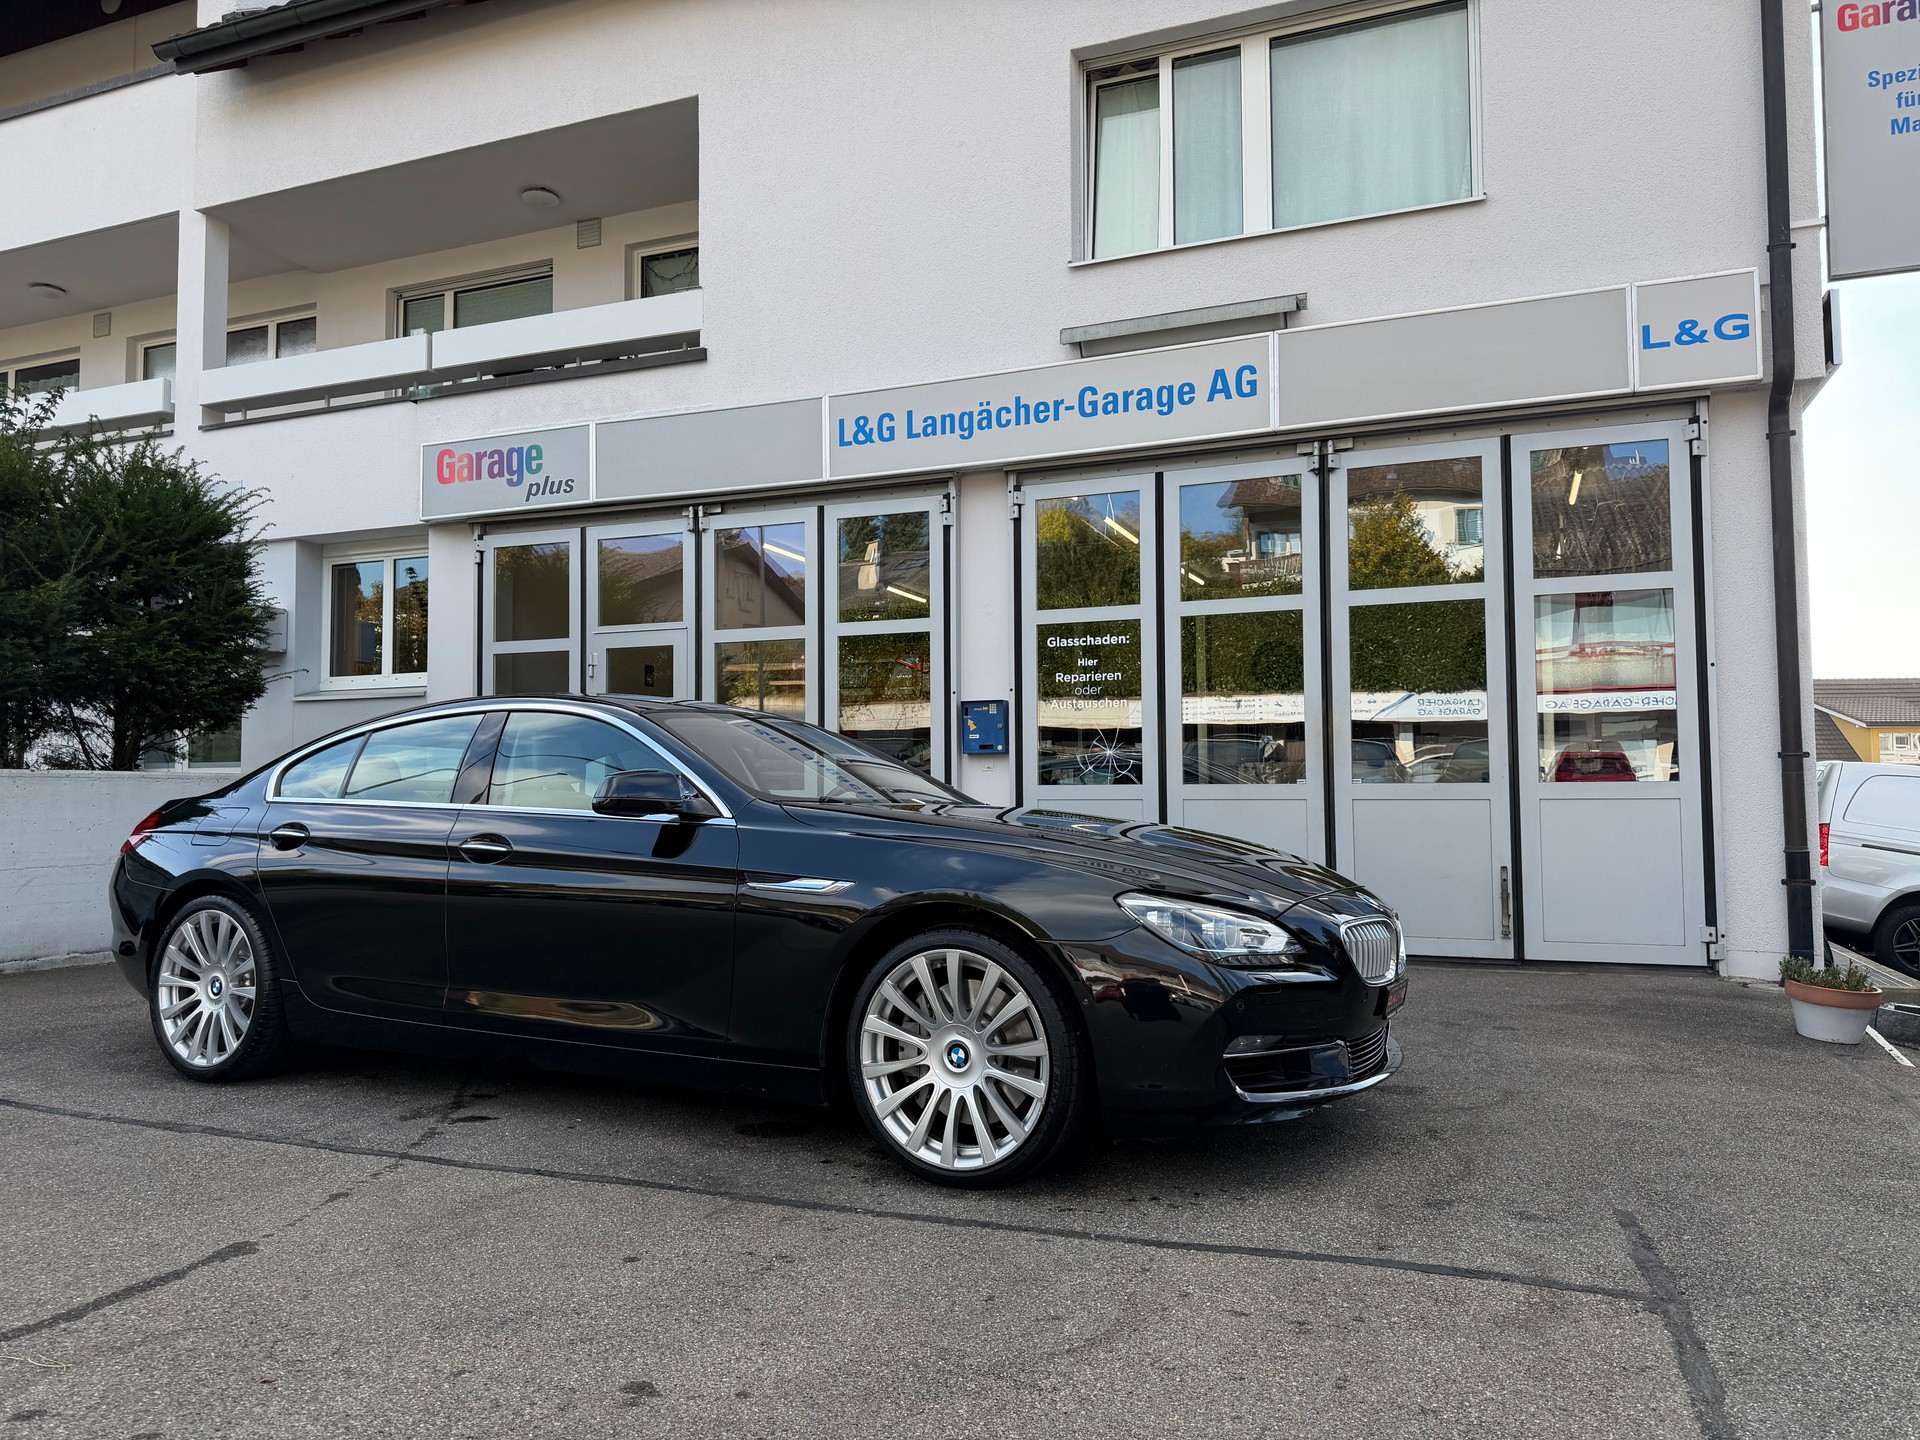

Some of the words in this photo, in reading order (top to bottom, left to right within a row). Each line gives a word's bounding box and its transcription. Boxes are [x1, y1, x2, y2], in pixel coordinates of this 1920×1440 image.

[1837, 0, 1920, 32] Gara
[1642, 313, 1750, 350] L&G
[838, 412, 896, 448] L&G
[906, 381, 1196, 441] Langächer-Garage
[1206, 364, 1258, 403] AG
[436, 444, 544, 488] Garage
[525, 475, 576, 503] plus
[1046, 633, 1131, 648] Glasschaden:
[1077, 657, 1099, 667] Hier
[1055, 671, 1122, 684] Reparieren
[1074, 685, 1103, 696] oder
[1050, 698, 1129, 710] Austauschen
